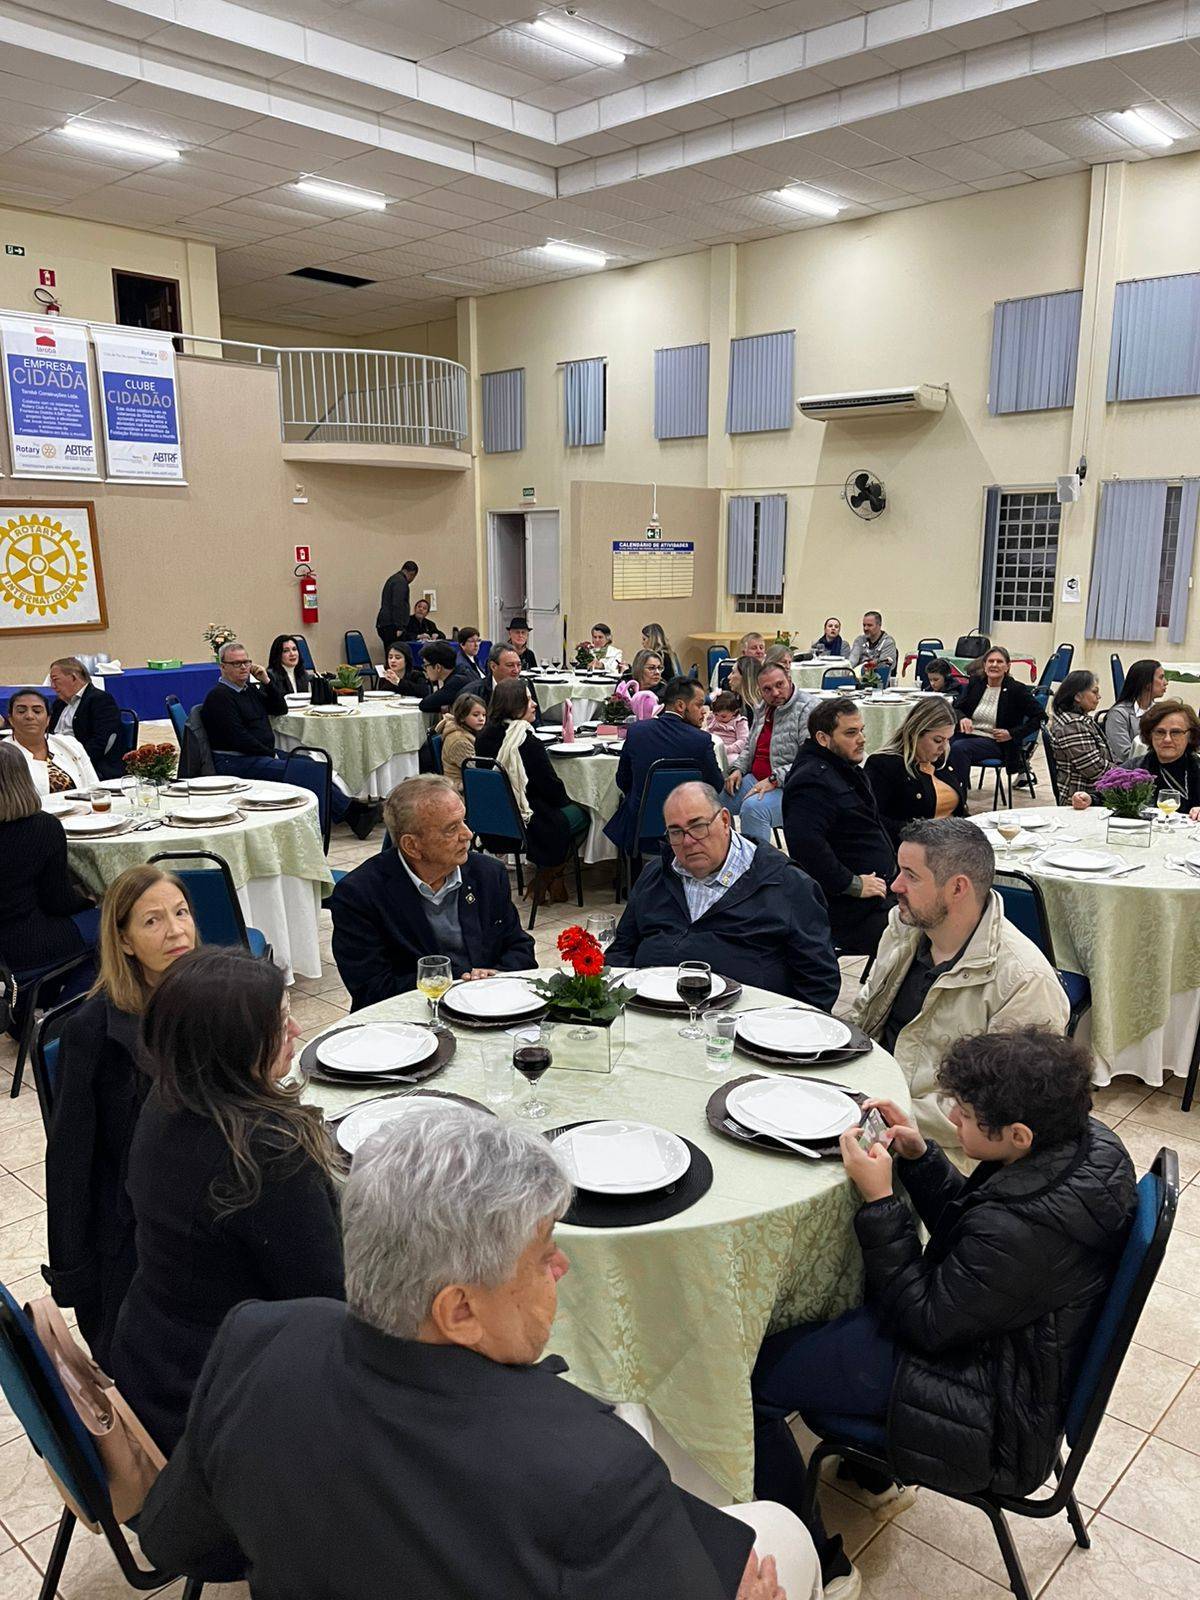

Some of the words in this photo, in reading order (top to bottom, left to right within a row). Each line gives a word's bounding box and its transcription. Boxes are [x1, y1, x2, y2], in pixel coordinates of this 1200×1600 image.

[23, 358, 74, 373] EMPRESA
[12, 367, 87, 391] CIDADÃ
[125, 379, 156, 392] CLUBE
[107, 390, 172, 408] CIDADÃO
[15, 444, 40, 455] Rotary
[64, 444, 94, 456] ABTRF
[152, 452, 178, 463] ABTRF
[14, 524, 56, 537] ROTARY
[4, 578, 75, 605] INTERNATIONAL
